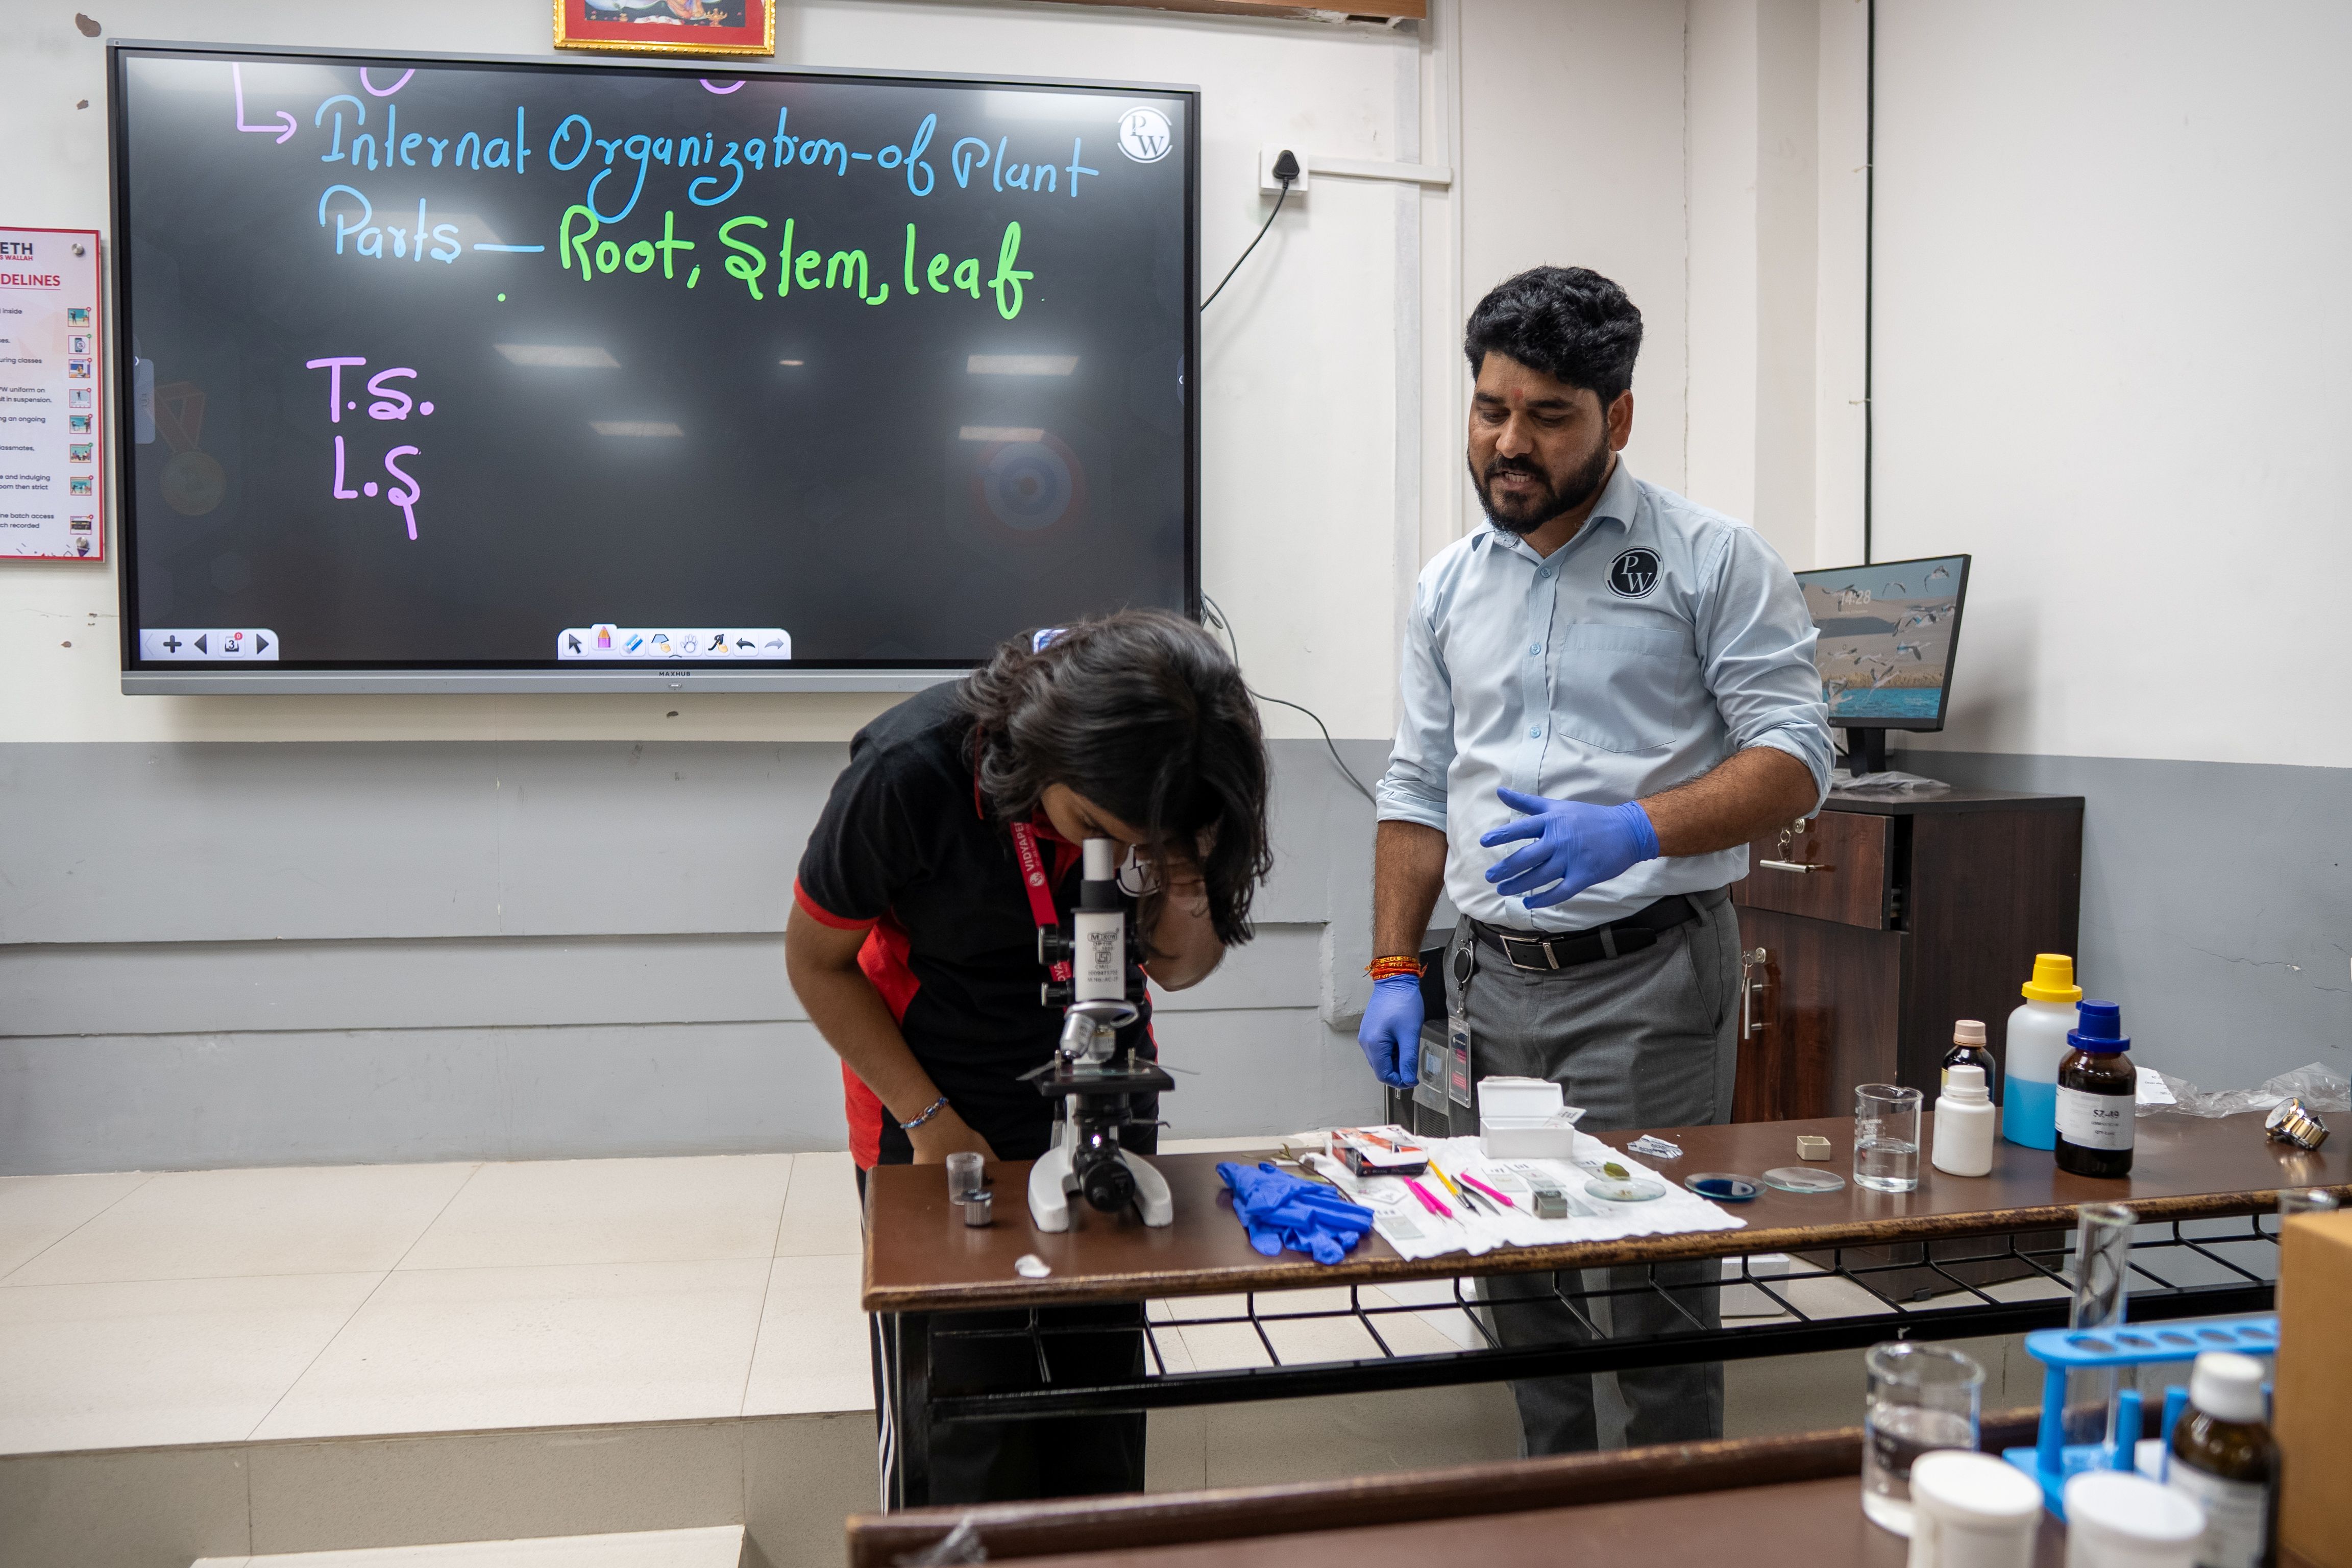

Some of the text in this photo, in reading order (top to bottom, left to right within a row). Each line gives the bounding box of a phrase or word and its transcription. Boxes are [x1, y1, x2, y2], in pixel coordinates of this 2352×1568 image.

[314, 94, 531, 175] Internal
[951, 135, 1100, 198] Plant
[317, 183, 462, 263] Parts
